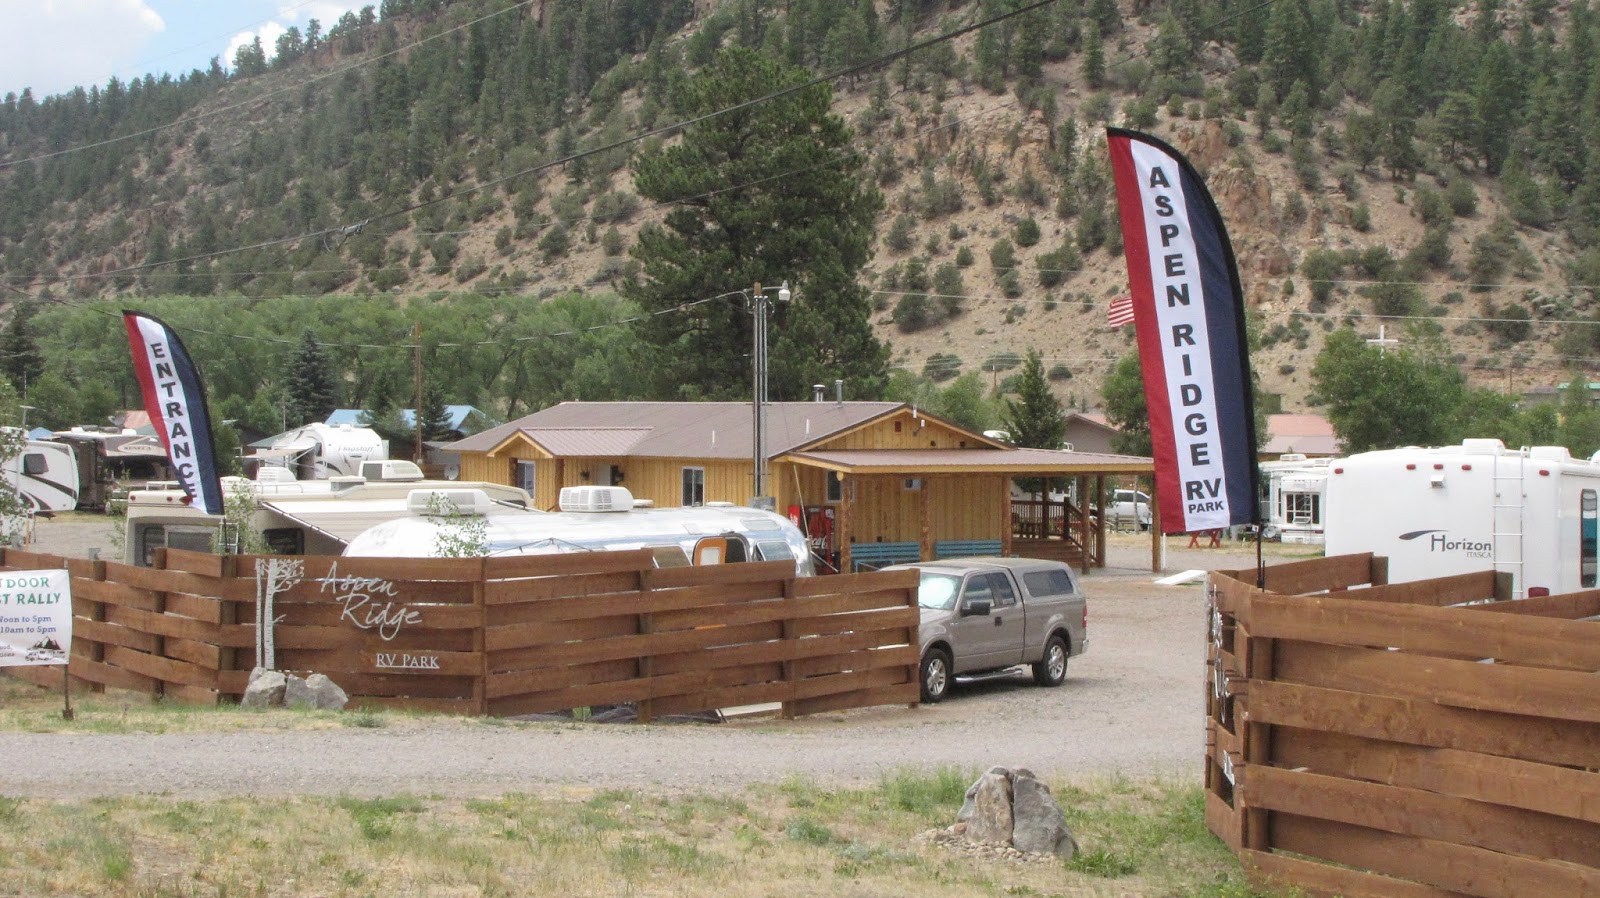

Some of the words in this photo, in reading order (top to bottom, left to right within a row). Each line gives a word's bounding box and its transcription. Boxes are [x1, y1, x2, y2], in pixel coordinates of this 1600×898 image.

[1149, 166, 1191, 308] ASPEN
[1171, 323, 1210, 466] RIDGE
[150, 342, 198, 498] ENTRANCE
[1185, 477, 1222, 501] RV
[1188, 500, 1225, 514] PARK
[1430, 534, 1492, 552] Horizon
[6, 577, 50, 588] DOOR
[320, 560, 399, 597] Aspen
[16, 592, 61, 605] RALLY
[32, 614, 52, 624] 5pm
[336, 593, 423, 641] Ridge
[37, 625, 56, 634] 5pm
[376, 653, 397, 668] RV
